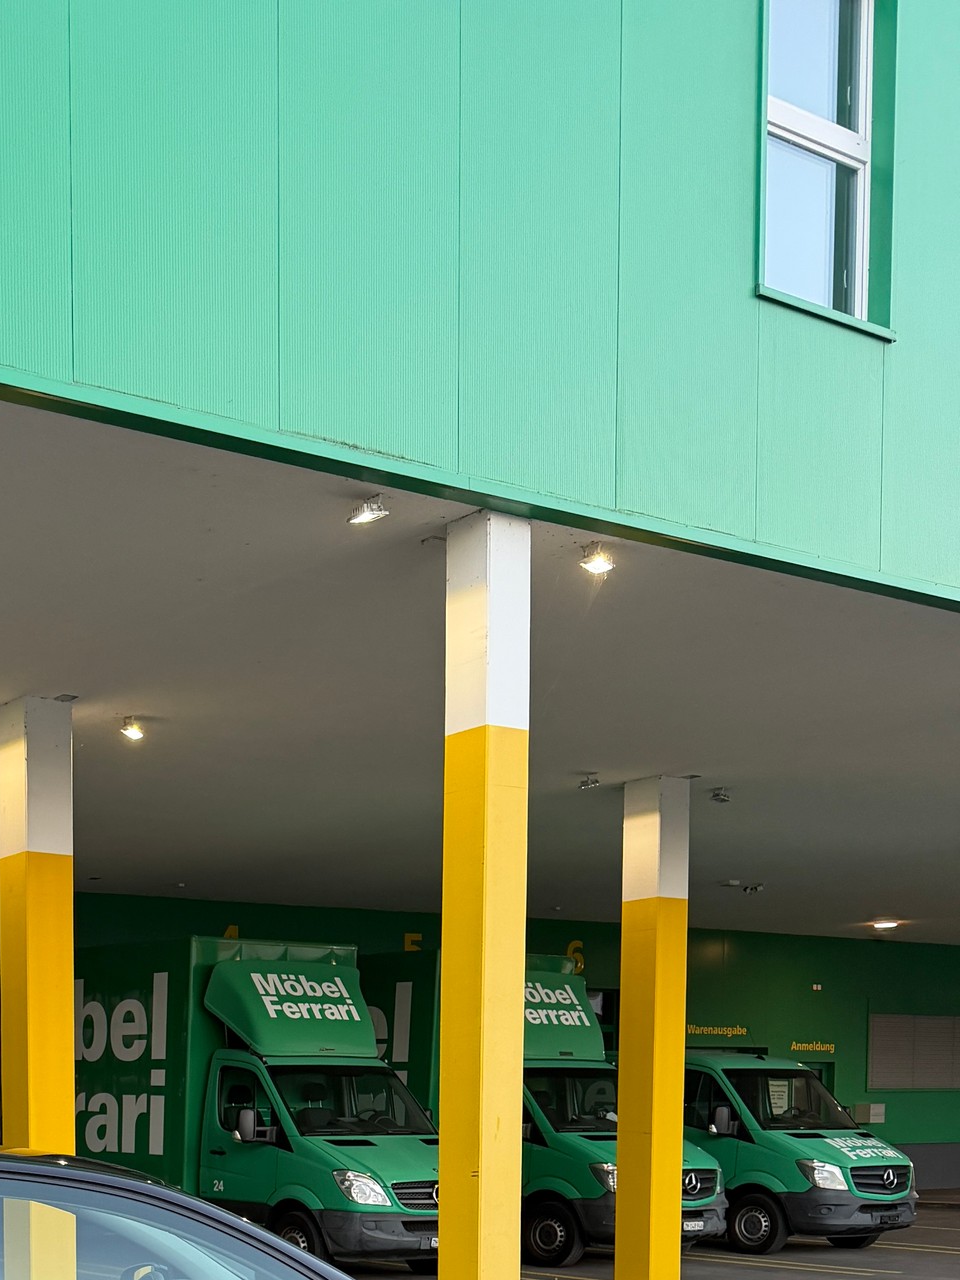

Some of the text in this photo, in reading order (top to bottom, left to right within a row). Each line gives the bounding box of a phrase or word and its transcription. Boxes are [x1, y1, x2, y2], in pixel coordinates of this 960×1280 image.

[567, 940, 584, 975] 6
[250, 973, 350, 998] Möbel
[524, 982, 579, 1005] öbel
[75, 972, 168, 1062] bel
[261, 996, 361, 1021] Ferrari
[525, 1005, 591, 1026] errari
[687, 1024, 747, 1037] Warenausgabe
[791, 1041, 835, 1053] Anmeldung
[824, 1136, 889, 1150] Möbel
[841, 1147, 903, 1160] Ferrari
[213, 1179, 224, 1192] 24
